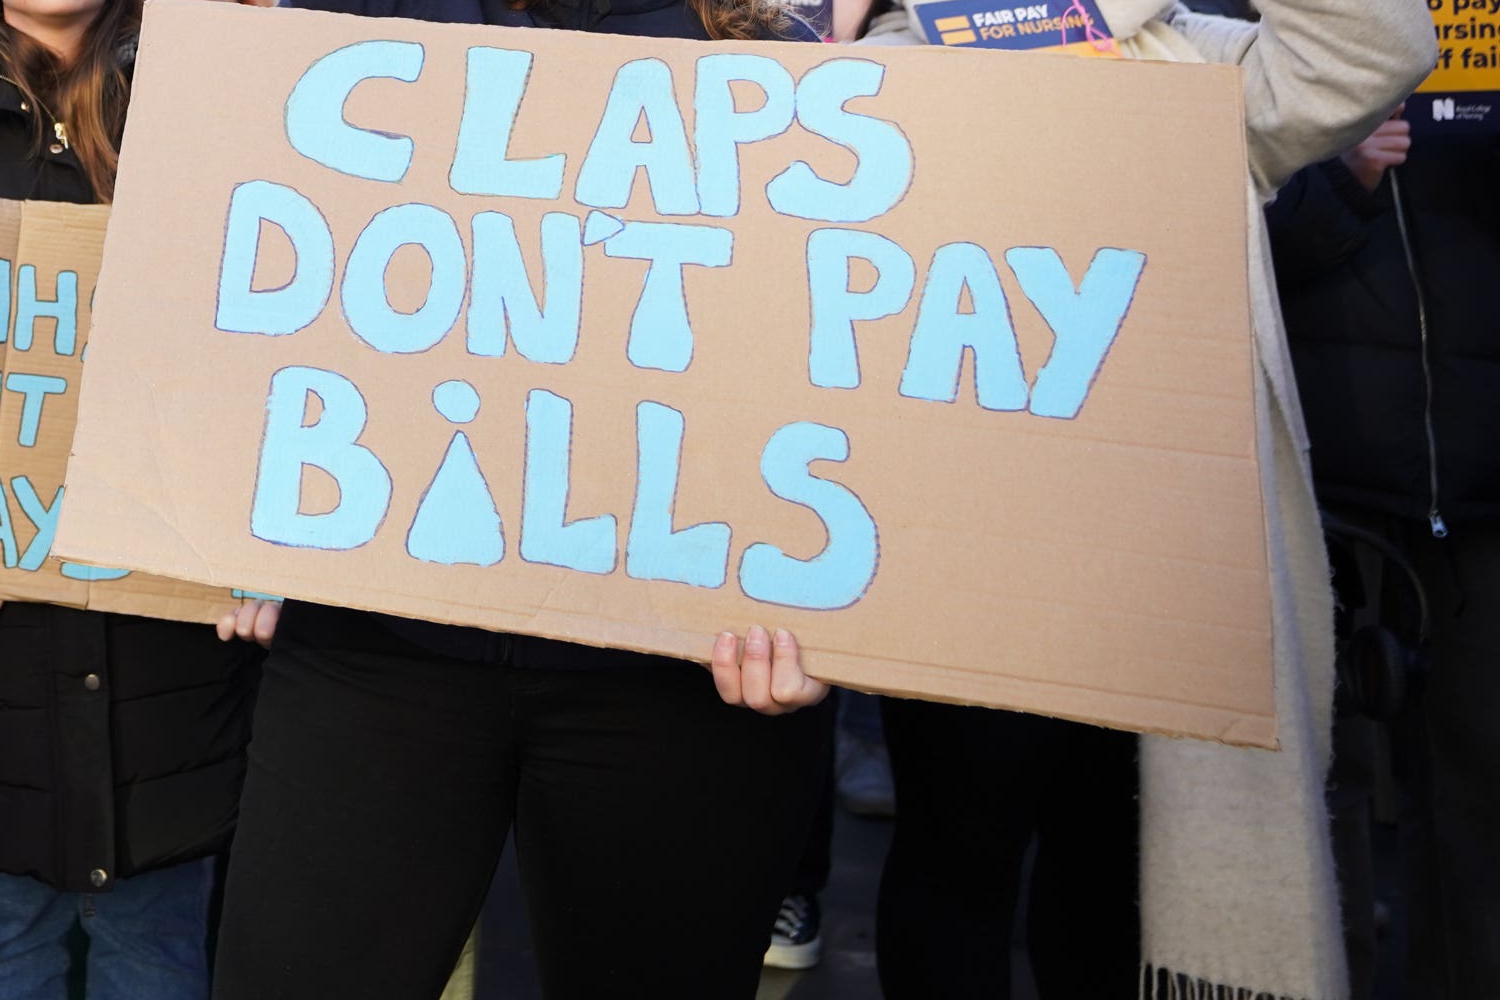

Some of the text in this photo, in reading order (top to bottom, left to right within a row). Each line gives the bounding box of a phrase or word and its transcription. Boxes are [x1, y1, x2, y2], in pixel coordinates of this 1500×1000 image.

[972, 3, 1049, 27] FAIR PAY
[978, 12, 1094, 41] FOR NURSING
[284, 39, 915, 222] CLAPS
[214, 180, 1147, 420] DON'T PAY
